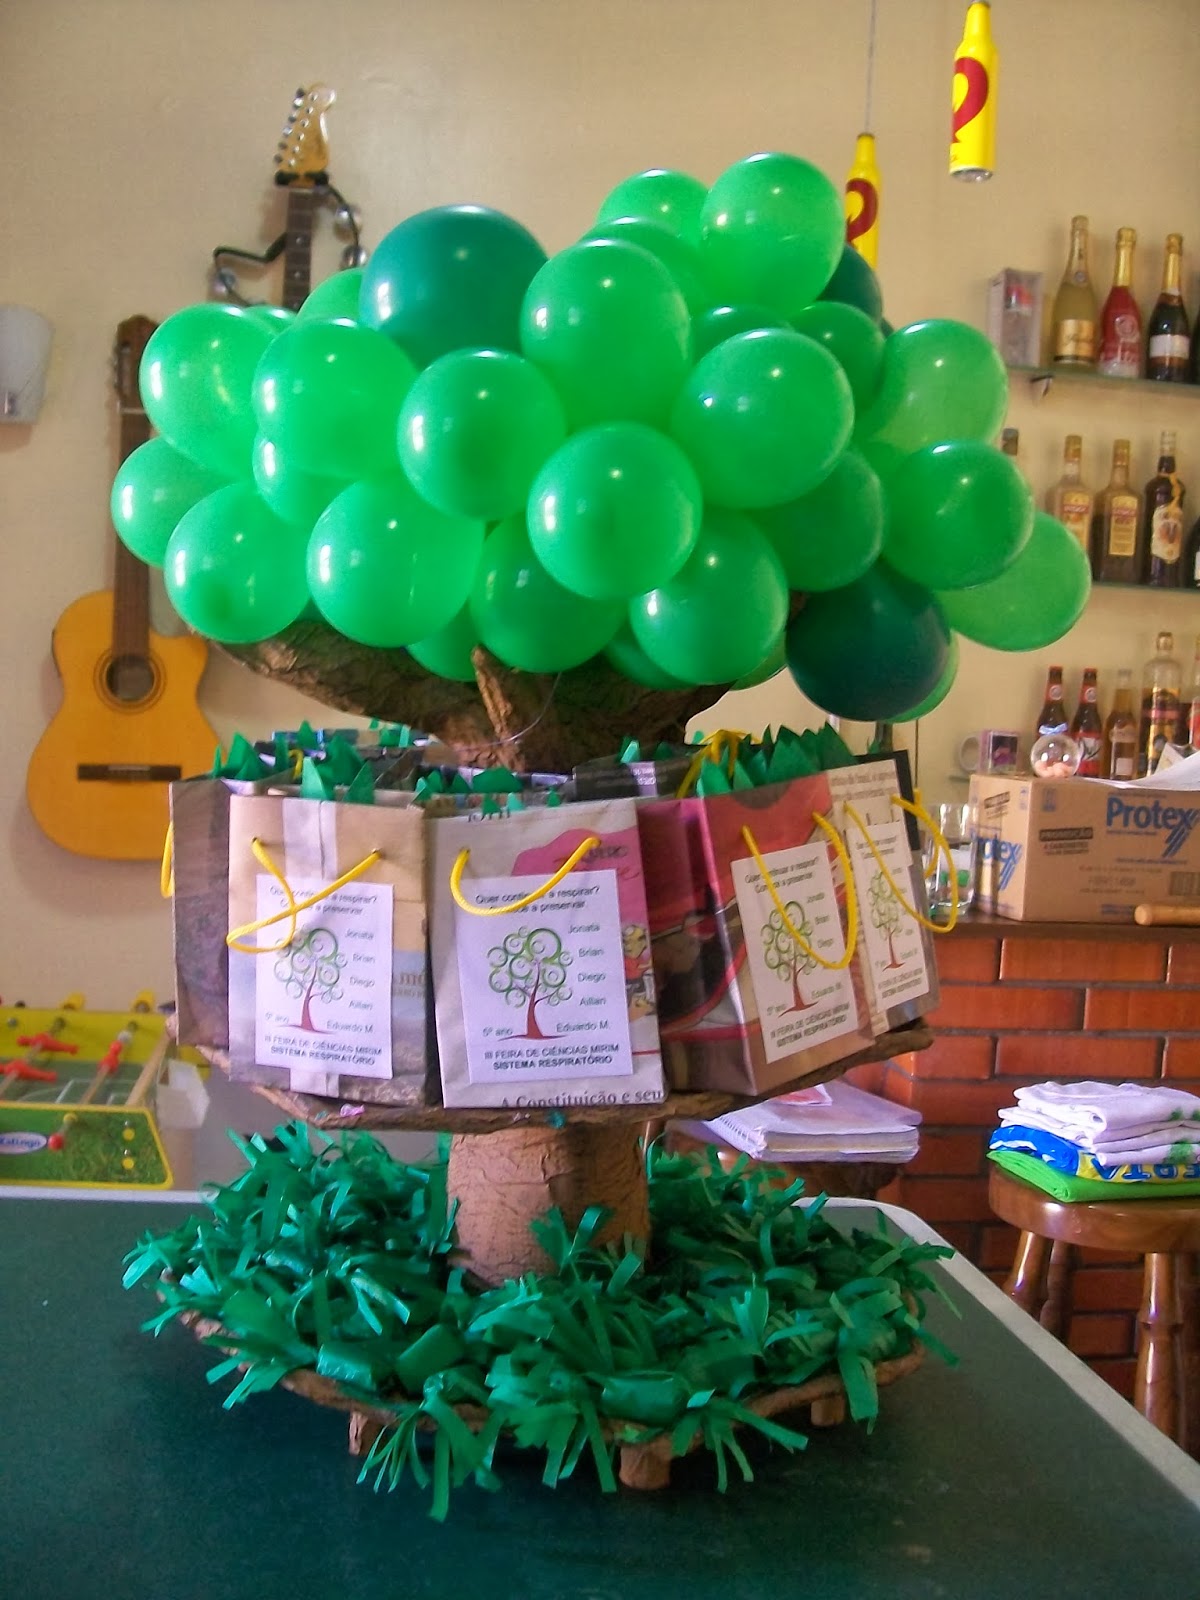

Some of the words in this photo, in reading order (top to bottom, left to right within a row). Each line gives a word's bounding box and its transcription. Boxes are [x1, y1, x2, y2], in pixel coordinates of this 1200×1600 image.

[1106, 797, 1200, 850] Protex
[475, 894, 498, 904] Quer
[558, 886, 600, 899] respirar?
[568, 923, 600, 934] Jonata
[579, 947, 604, 957] Brian
[577, 972, 606, 983] Diego
[495, 1027, 513, 1036] ano
[556, 1022, 596, 1033] Eduardo
[270, 1046, 306, 1058] SISTEMA
[308, 1050, 376, 1066] RESPIRATÓRIO
[495, 1049, 522, 1060] FEIRA
[525, 1048, 539, 1058] DE
[541, 1045, 588, 1057] CIÊNCIAS
[590, 1043, 619, 1054] MIRIM
[493, 1060, 536, 1070] SISTEMA
[538, 1055, 613, 1068] RESPIRATÓRIO
